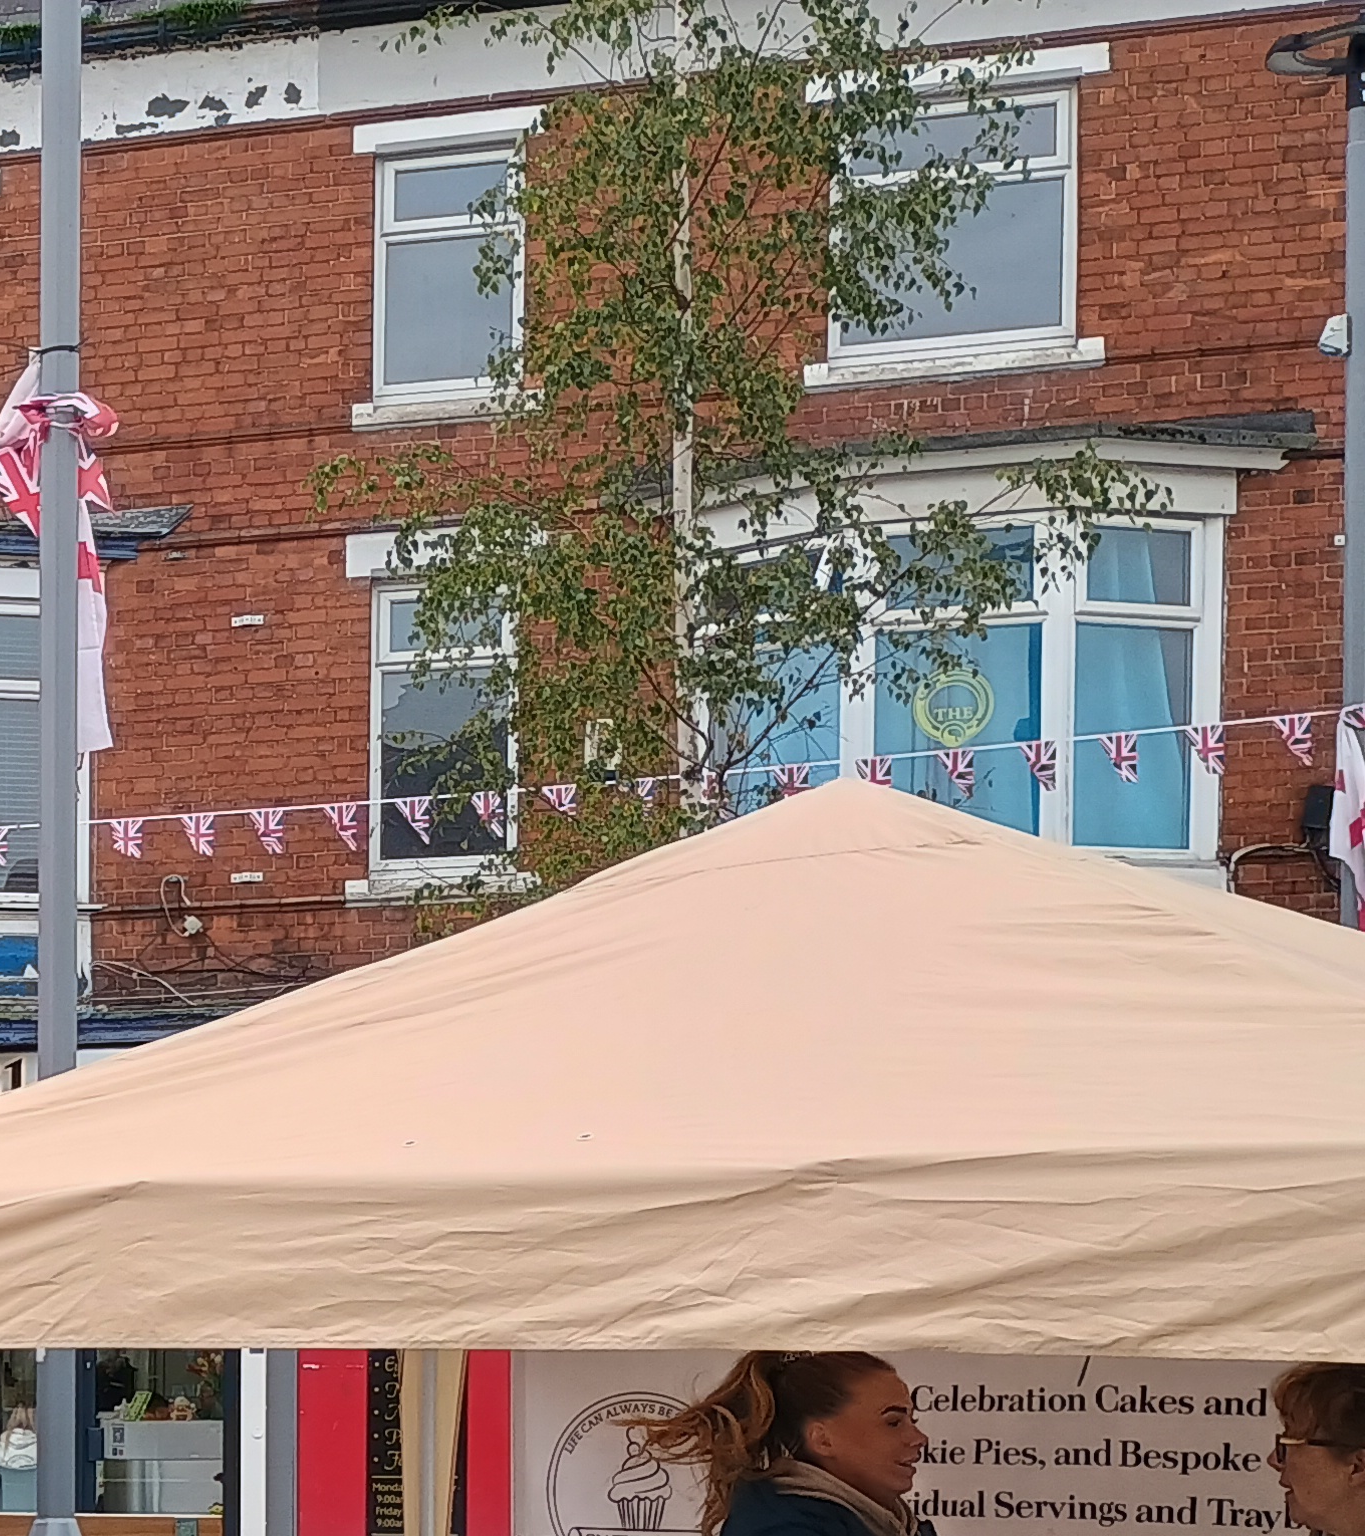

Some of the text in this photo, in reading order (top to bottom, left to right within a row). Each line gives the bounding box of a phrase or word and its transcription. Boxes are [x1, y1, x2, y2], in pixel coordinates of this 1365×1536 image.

[933, 707, 973, 722] THE
[911, 1383, 1267, 1417] Celebration Cakes and
[565, 1403, 672, 1455] LIFE CAN ALWAYS BE
[973, 1439, 1046, 1470] Pies,
[1054, 1439, 1111, 1468] and
[1118, 1441, 1261, 1475] Bespoke
[376, 1507, 402, 1517] Friday
[909, 1490, 985, 1518] idual
[993, 1491, 1128, 1527] Servings
[1135, 1496, 1197, 1525] and
